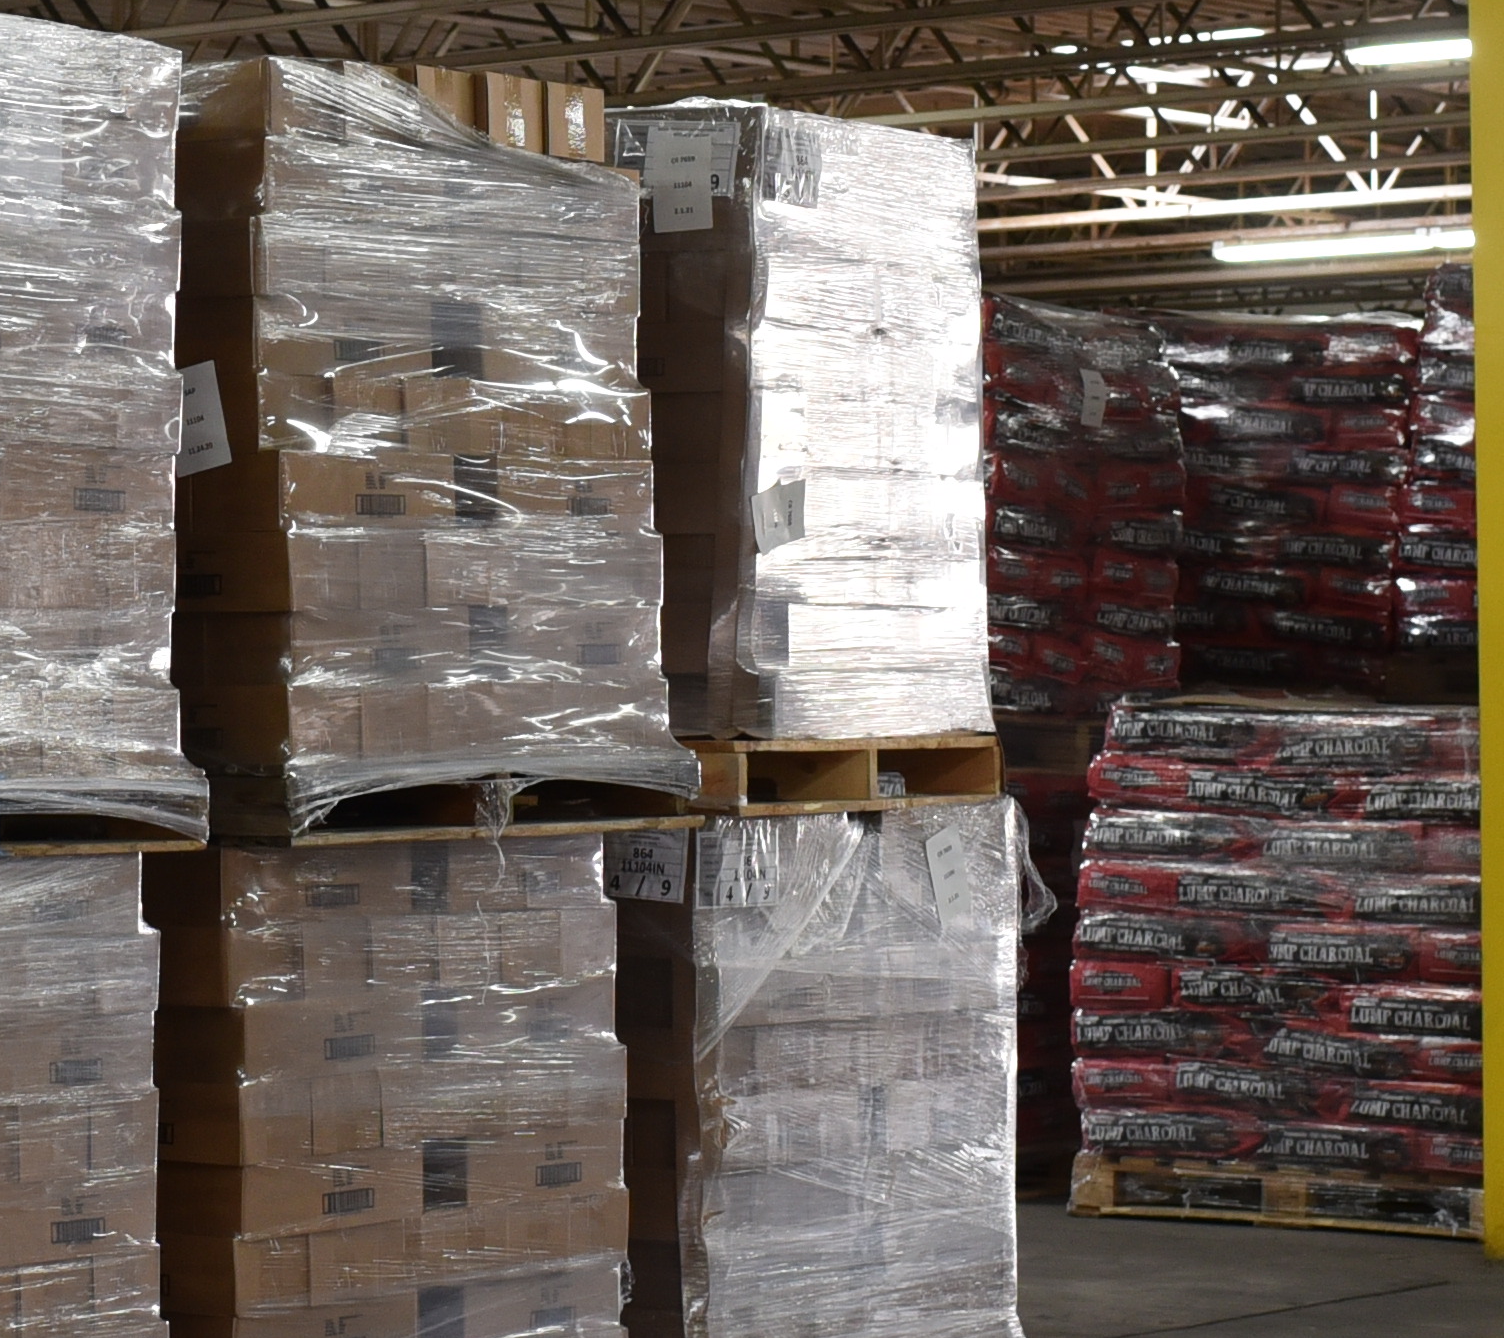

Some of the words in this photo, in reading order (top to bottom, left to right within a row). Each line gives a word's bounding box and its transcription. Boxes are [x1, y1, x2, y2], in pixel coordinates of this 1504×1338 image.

[711, 174, 719, 190] 9
[1186, 781, 1226, 797] LUMP
[633, 848, 653, 859] 864
[1263, 840, 1300, 855] LUMP
[1303, 841, 1377, 858] CHARCOAL
[621, 860, 665, 875] 11104IN
[610, 875, 620, 890] 4
[660, 879, 671, 896] 9
[1179, 886, 1217, 901] LUMP
[1356, 898, 1396, 911] LUMP
[1399, 898, 1475, 913] CHARCOAL
[1080, 926, 1116, 941] LUMP
[1300, 946, 1374, 963] CHARCOAL
[1181, 982, 1218, 995] LUMP
[1351, 1008, 1391, 1024] LUMP
[1395, 1010, 1471, 1030] CHARCOAL
[1176, 1074, 1214, 1088] LUMP
[1216, 1078, 1285, 1098] CHARCOAL
[1351, 1100, 1390, 1116] LUMP
[1392, 1105, 1468, 1124] CHARCOAL
[1088, 1125, 1123, 1140] LUMP
[1127, 1125, 1196, 1141] CHARCOAL
[1296, 1139, 1369, 1158] CHARCOAL
